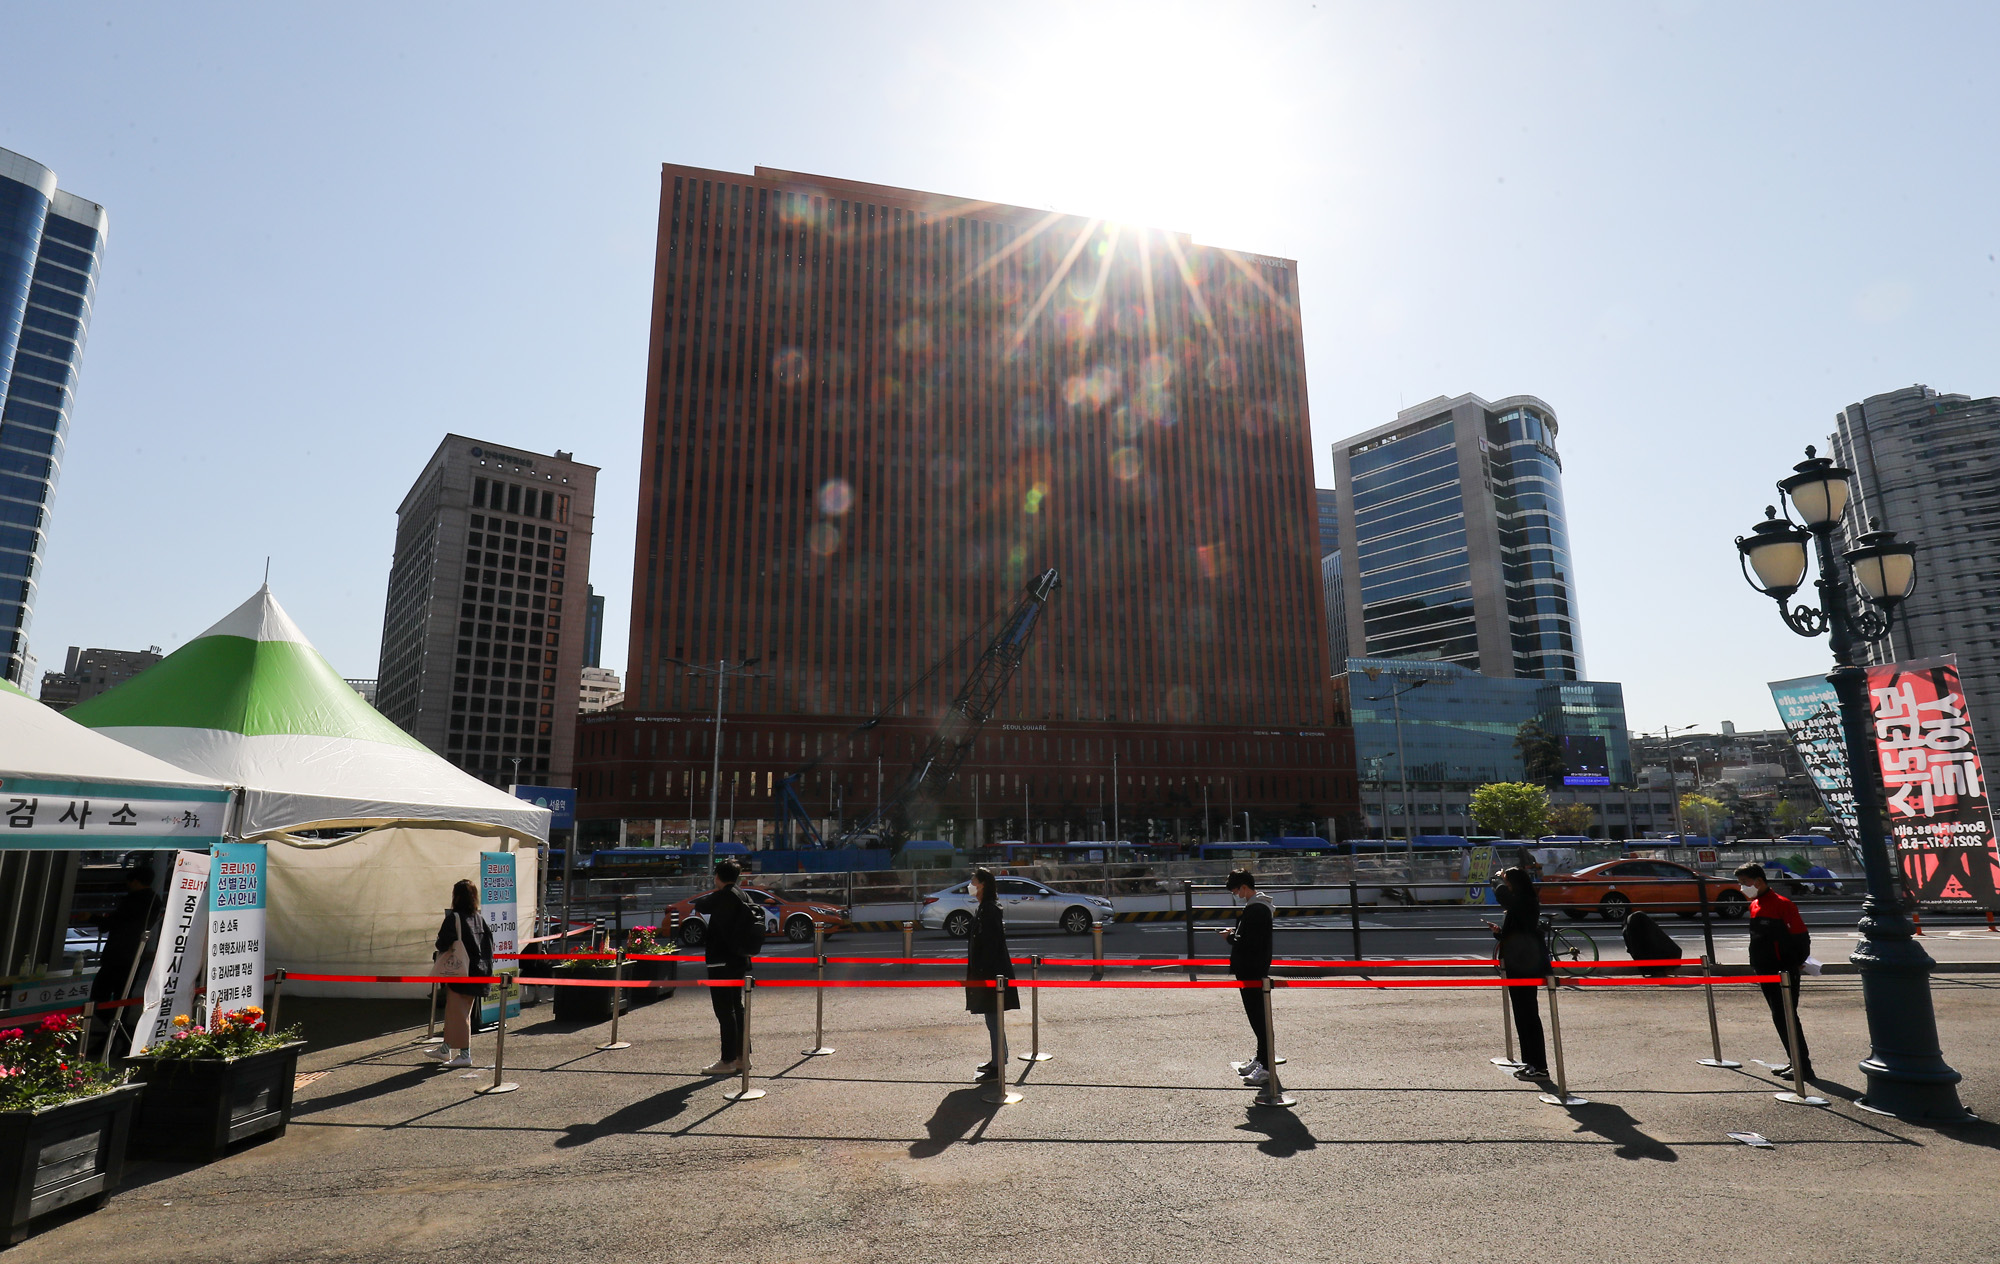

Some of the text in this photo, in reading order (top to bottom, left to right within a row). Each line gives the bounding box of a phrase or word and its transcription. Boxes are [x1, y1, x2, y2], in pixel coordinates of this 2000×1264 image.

[550, 799, 566, 811] 서울역
[220, 862, 257, 875] 코로나19
[487, 864, 510, 874] 코로나19
[180, 878, 208, 892] 코로나19
[218, 877, 258, 891] 선별검사
[483, 877, 514, 888] 중구선별검사소
[217, 892, 257, 907] 순서안내
[487, 890, 510, 901] 운영시간
[220, 919, 226, 933] 손
[227, 919, 239, 932] 소독
[489, 922, 516, 933] :00~17:00
[219, 942, 247, 956] 역학조사서
[247, 939, 259, 953] 작성
[153, 895, 197, 1046] 중구임시선별검
[218, 964, 241, 980] 검사라벨
[241, 962, 253, 976] 작성
[54, 988, 65, 1000] 손
[68, 984, 89, 997] 소독
[241, 985, 253, 999] 수령
